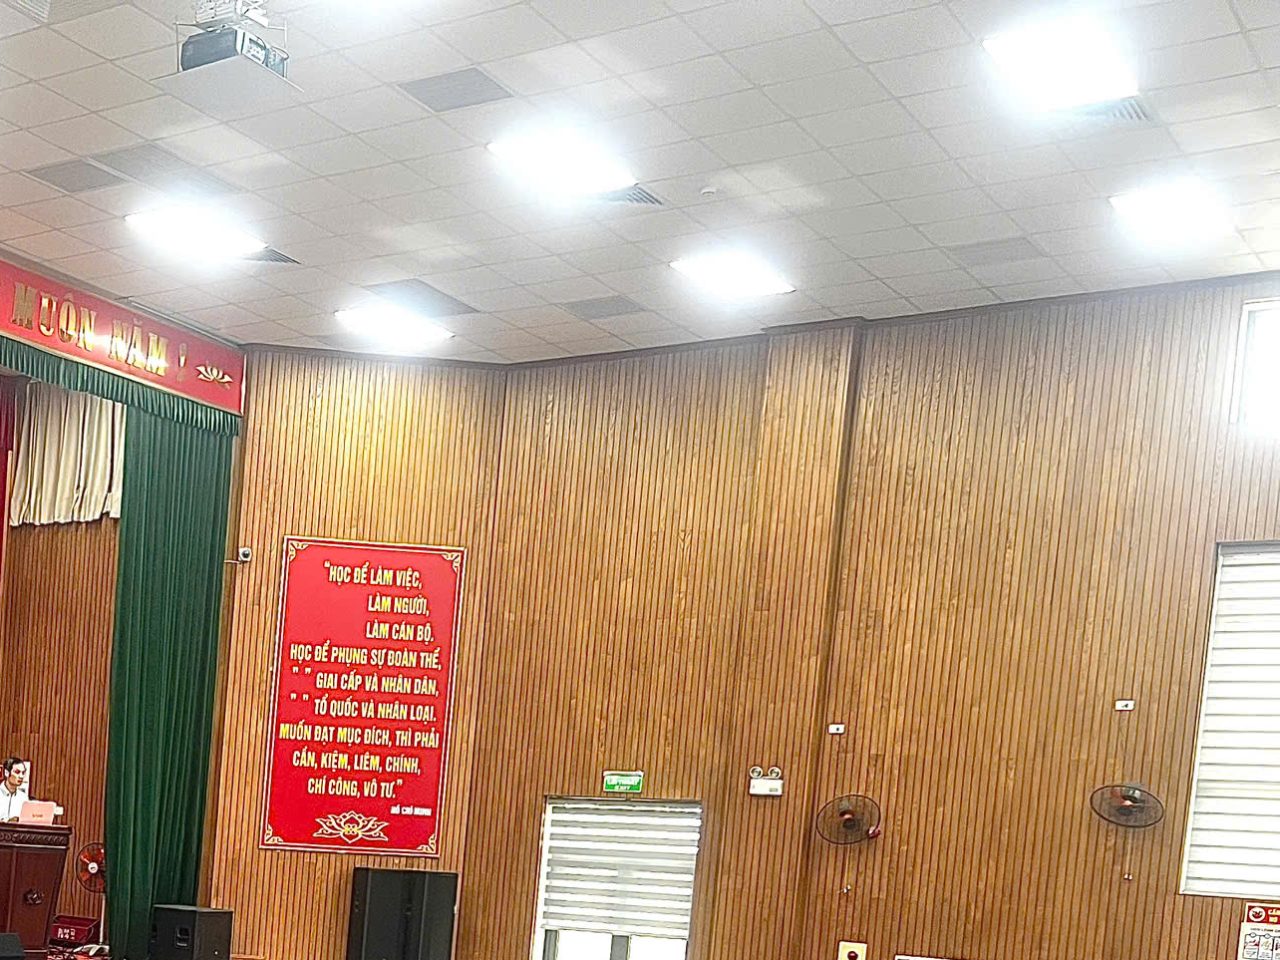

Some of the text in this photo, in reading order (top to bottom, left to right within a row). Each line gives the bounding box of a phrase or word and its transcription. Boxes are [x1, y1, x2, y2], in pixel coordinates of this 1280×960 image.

[11, 281, 98, 351] MUÔN
[108, 318, 170, 377] NĂM
[353, 561, 369, 584] ĐỂ
[370, 565, 394, 586] LÀM
[396, 567, 422, 590] VIỆC,
[367, 592, 430, 617] LÀM NGƯỜI,
[365, 619, 434, 645] LÀM CÁN BỘ.
[290, 643, 312, 664] HỌC
[314, 639, 331, 662] ĐỂ
[330, 646, 368, 667] PHỤNG
[370, 648, 387, 669] SỰ
[387, 647, 417, 667] ĐOÀN
[315, 672, 338, 689] GIAI
[340, 669, 362, 691] CẤP
[364, 672, 379, 692] VÀ
[381, 674, 411, 694] NHÂN
[413, 676, 439, 698] DÂN,
[314, 693, 329, 715] TỔ
[329, 695, 359, 718] QUỐC
[361, 699, 375, 718] VÀ
[377, 700, 408, 720] NHÂN
[409, 705, 437, 725] LOẠI.
[278, 719, 439, 748] MUỐN ĐẠT MỤC ĐÍCH, THÌ PHẢI
[320, 750, 351, 773] KIỆM,
[353, 752, 383, 773] LIÊM,
[385, 754, 421, 776] CHÍNH,
[307, 775, 326, 794] CHÍ
[328, 776, 360, 798] CÔNG,
[363, 778, 377, 798] VÔ
